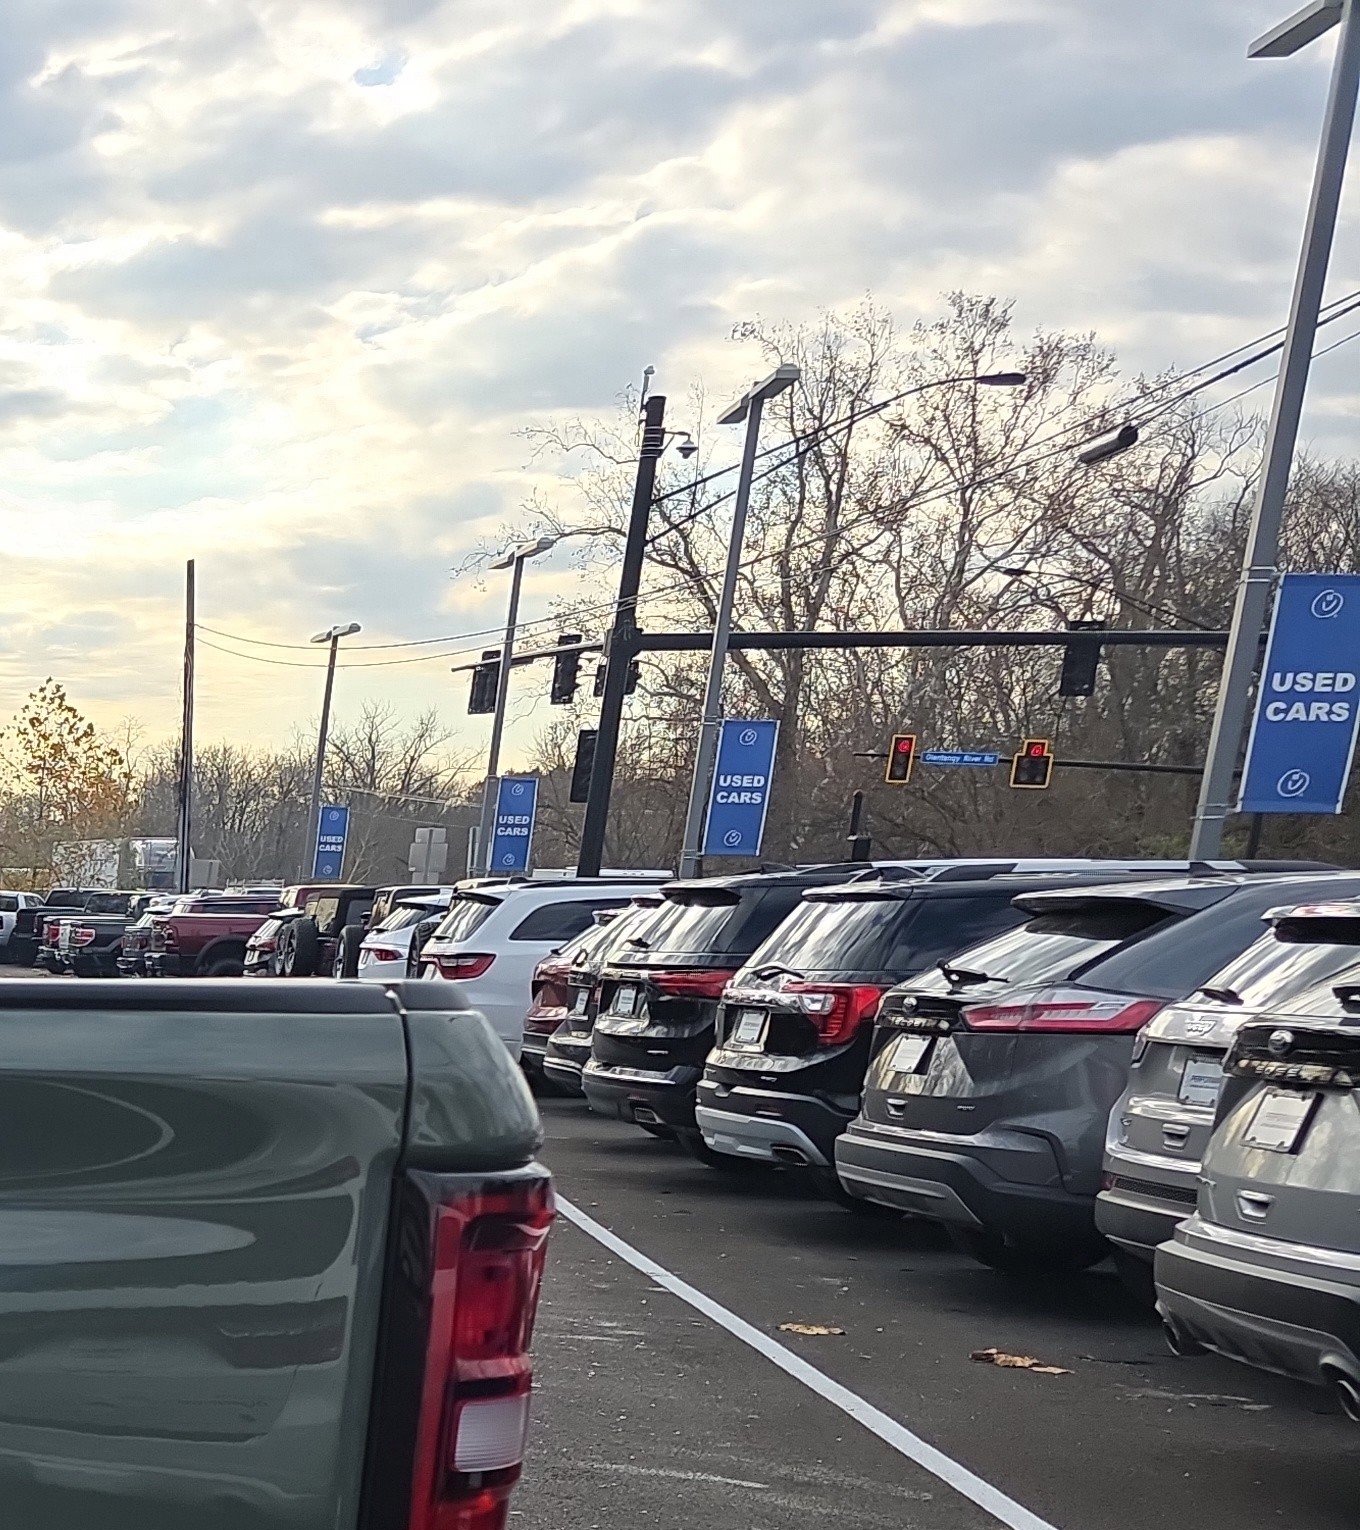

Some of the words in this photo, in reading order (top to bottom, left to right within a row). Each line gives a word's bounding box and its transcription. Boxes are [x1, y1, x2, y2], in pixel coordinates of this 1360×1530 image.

[1271, 672, 1356, 693] USED
[1265, 701, 1350, 722] CARS
[719, 774, 765, 787] USED
[716, 791, 762, 804] CARS
[499, 815, 530, 825] USED
[496, 827, 529, 836] CARS
[320, 835, 344, 843] USED
[318, 844, 343, 852] CARS
